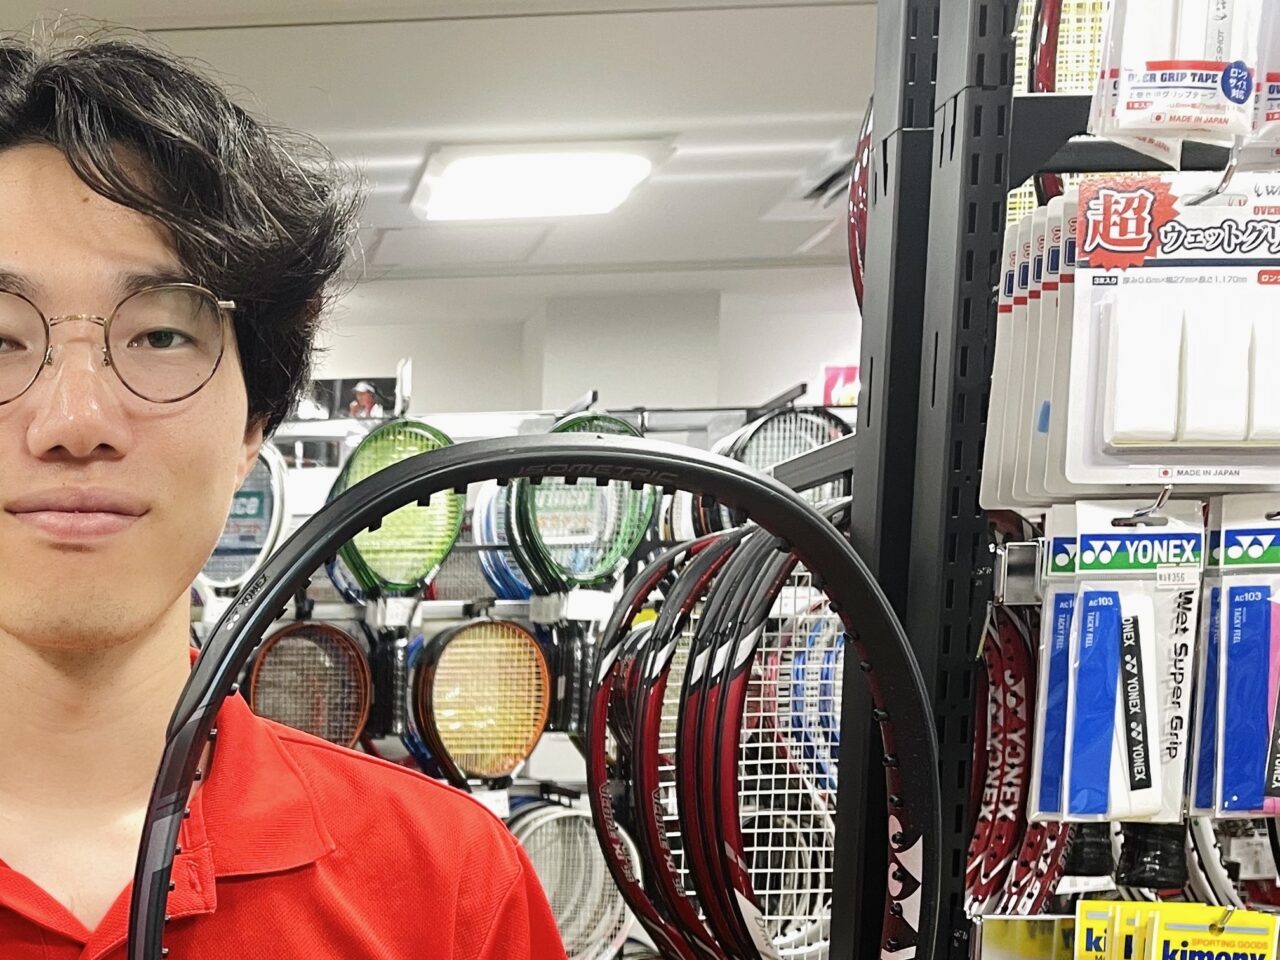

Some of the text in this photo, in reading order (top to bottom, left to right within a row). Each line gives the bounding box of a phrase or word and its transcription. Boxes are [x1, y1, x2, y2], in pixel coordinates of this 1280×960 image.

[1160, 73, 1218, 83] GRIP TAPE
[1085, 188, 1154, 253] 超
[1125, 539, 1197, 564] YONEX
[1166, 590, 1195, 760] Wet Super Grip
[1127, 676, 1142, 715] YONEX
[996, 730, 1026, 822] YONEX
[1132, 743, 1147, 782] YONEX
[1191, 939, 1269, 950] SPORTING GOODS
